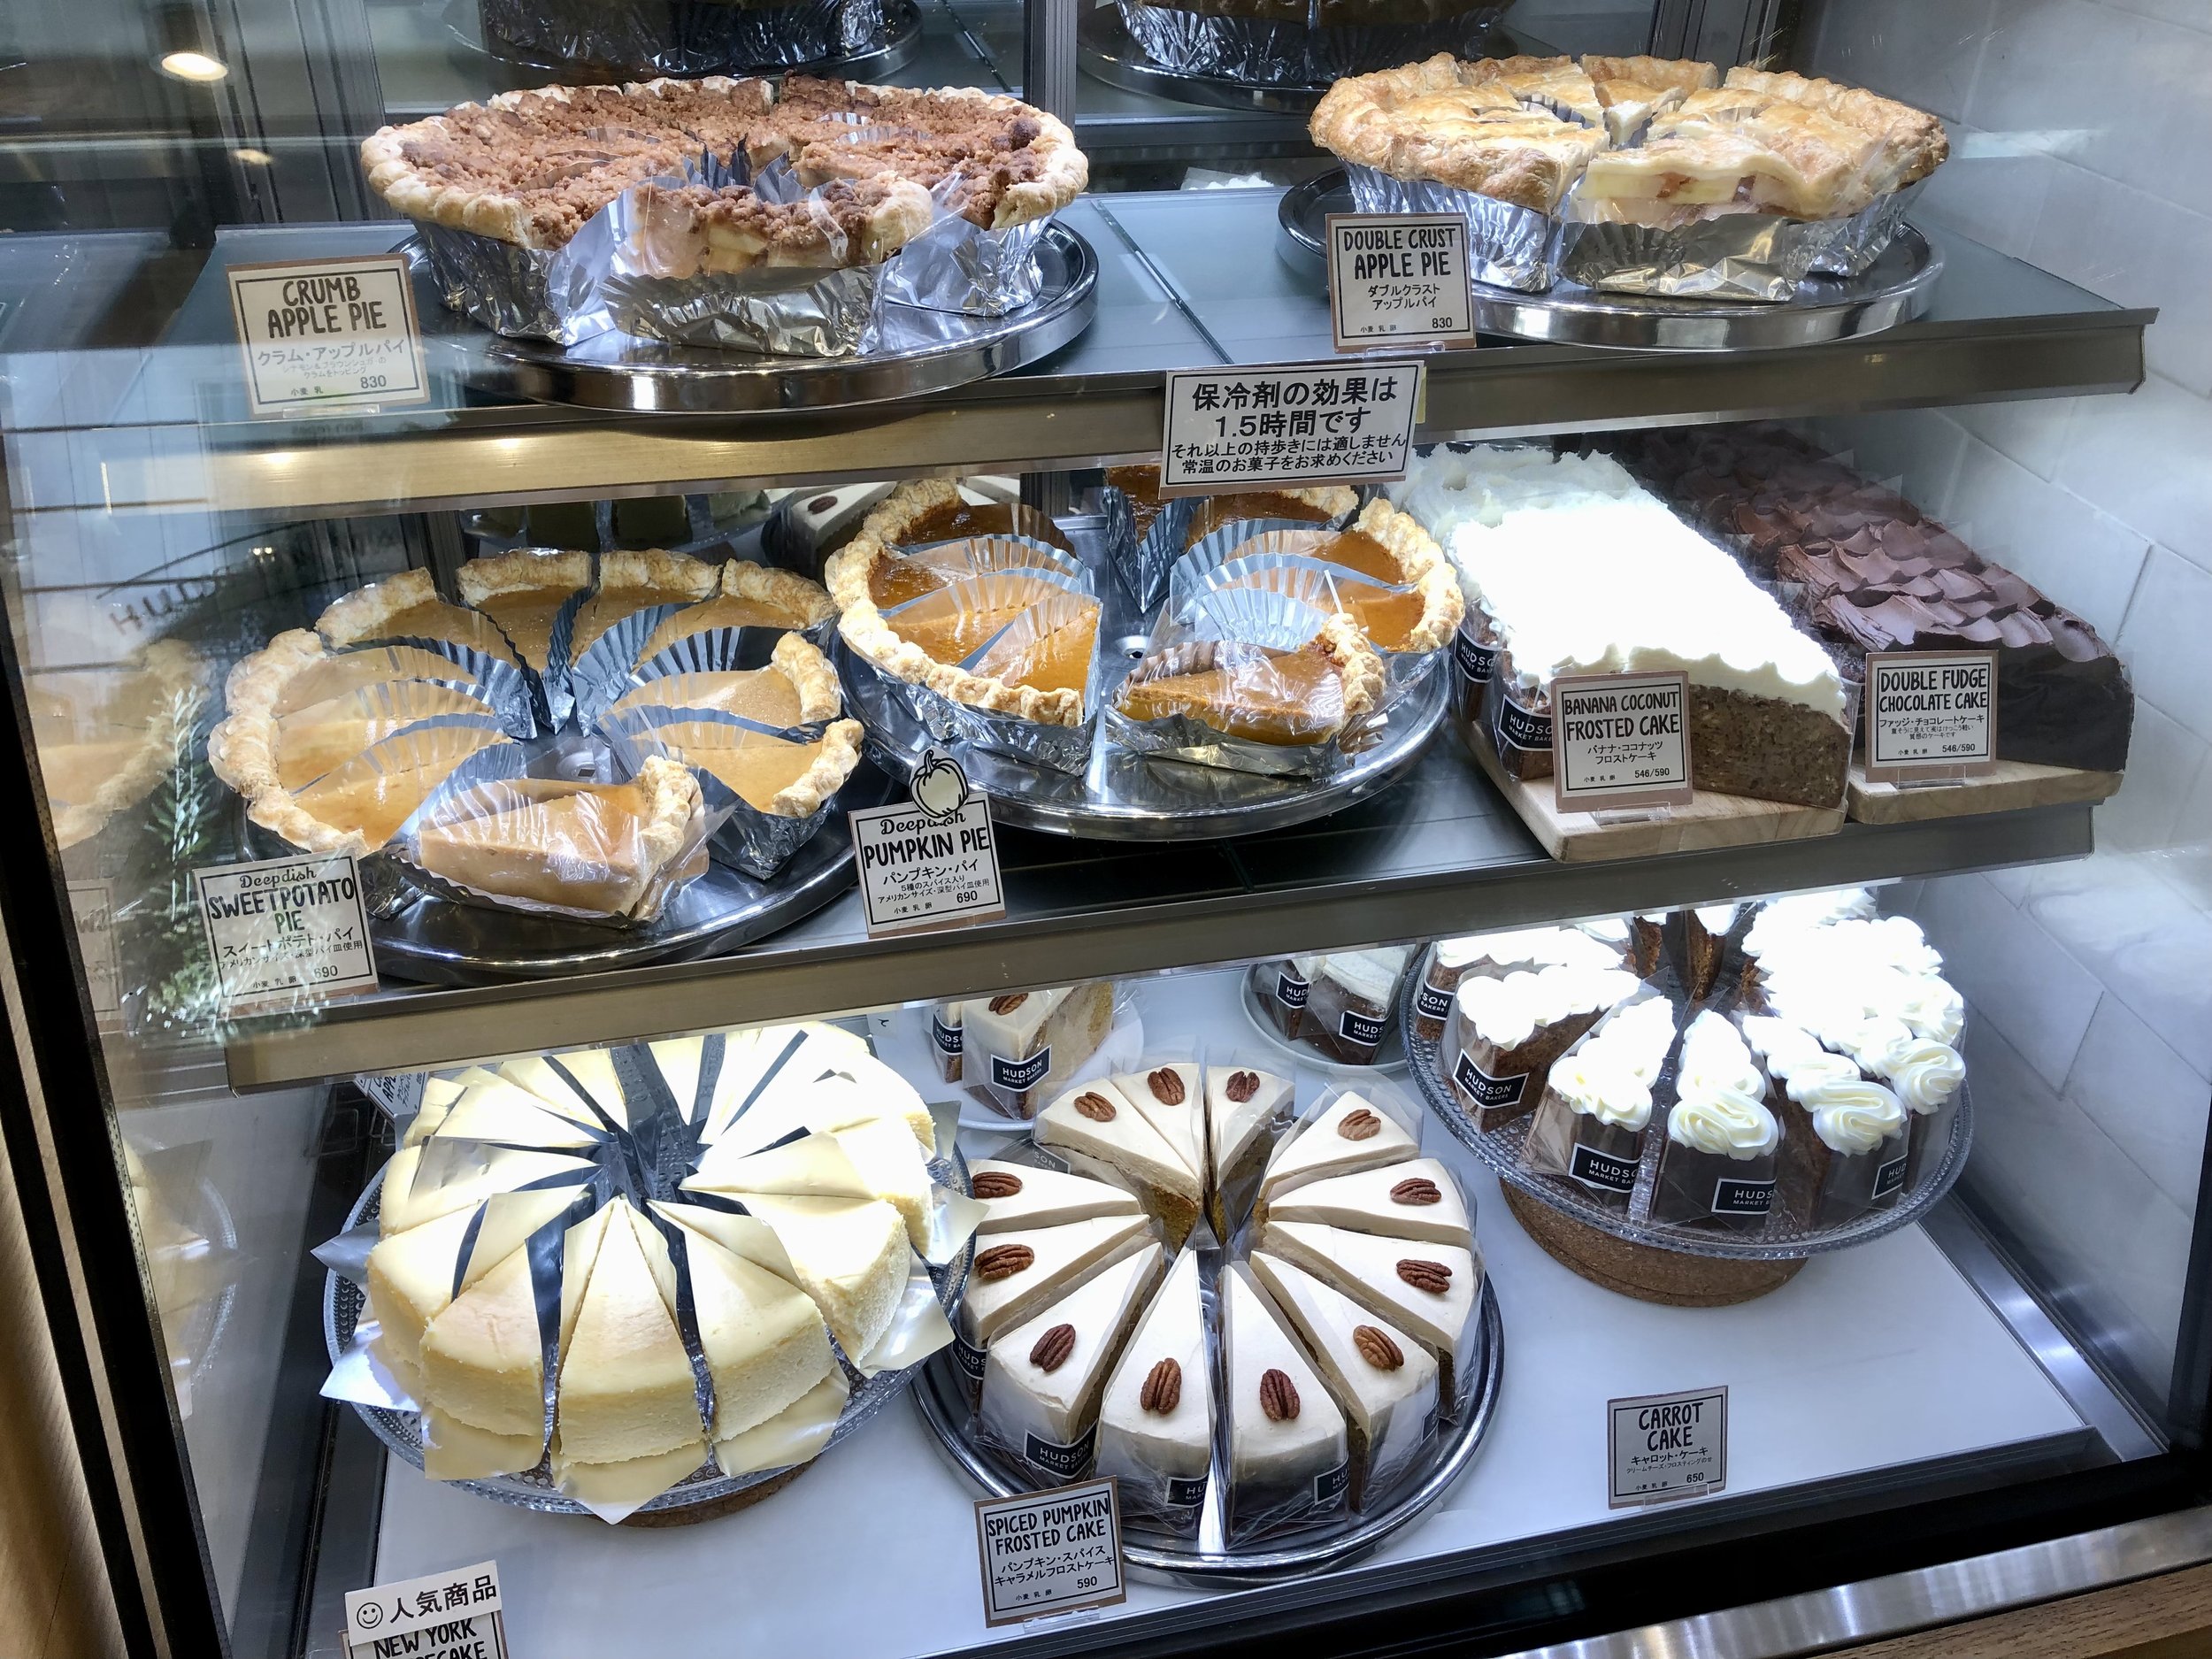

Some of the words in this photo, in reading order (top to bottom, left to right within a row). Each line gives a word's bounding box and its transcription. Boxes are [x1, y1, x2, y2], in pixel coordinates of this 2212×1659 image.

[1344, 230, 1403, 251] DOUBLE
[1409, 228, 1455, 249] CRUST
[1355, 253, 1414, 280] APPLE
[1421, 251, 1451, 276] PIE
[283, 276, 360, 306] CRUMB
[1368, 283, 1440, 297] ダブルクラスト
[1372, 296, 1437, 311] アップルパイ
[268, 305, 342, 338] APPLE
[348, 301, 387, 331] PIE
[1432, 317, 1453, 328] 830
[257, 339, 404, 366] クラム・アップルパイ
[360, 375, 387, 388] 830
[1192, 376, 1398, 411] 保冷剤の効果は
[1216, 407, 1371, 438] 1.5時間です
[1171, 433, 1406, 459] それ以上の持歩きには適しません
[1182, 449, 1394, 474] 常温のお菓子をお求めください
[1880, 671, 1938, 693] DOUBLE
[1942, 668, 1987, 689] FUDGE
[1564, 695, 1617, 715] BANANA
[1621, 692, 1678, 711] COCONUT
[1879, 694, 1951, 712] CHOCOLATE
[1955, 692, 1987, 709] CAKE
[1566, 718, 1633, 741] FROSTED
[1640, 714, 1679, 736] CAKE
[1879, 714, 1985, 728] ファッジ・チョコレートケーキ
[1509, 725, 1532, 741] MARKET
[1587, 741, 1663, 755] バナナ・ココナッツ
[1595, 751, 1657, 764] フロストケーキ
[1942, 743, 1976, 753] 546/590
[1635, 767, 1670, 779] 546/590
[864, 832, 954, 869] PUMPKIN
[960, 826, 990, 853] PIE
[883, 858, 978, 885] パンプキン・パイ
[956, 890, 978, 903] 690
[274, 910, 304, 933] PIE
[314, 965, 338, 979] 690
[1353, 1029, 1377, 1039] MARKET
[1002, 1059, 1042, 1079] HUDSON
[1002, 1076, 1025, 1085] MARKET
[1464, 1077, 1484, 1097] MARKET
[1466, 1068, 1512, 1094] HUDSON
[1588, 1169, 1619, 1183] MARKET
[1639, 1402, 1703, 1431] CARROT
[1647, 1426, 1693, 1452] CAKE
[1039, 1455, 1069, 1470] MARKET
[1040, 1440, 1089, 1463] HUDSON
[1631, 1446, 1709, 1466] キャロット・ケーキ
[1686, 1472, 1704, 1484] 650
[987, 1512, 1037, 1537] SPICED
[1043, 1497, 1110, 1527] PUMPKIN
[996, 1529, 1060, 1555] FROSTED
[1066, 1519, 1106, 1543] CAKE
[1002, 1545, 1106, 1573] パンプキン・スパイス
[994, 1555, 1115, 1587] キャラメルフロストケーキ
[1077, 1576, 1097, 1589] 590
[389, 1574, 496, 1624] 人気商品
[1016, 1593, 1030, 1601] 小麦
[373, 1630, 419, 1659] NEW
[425, 1617, 477, 1647] YORK
